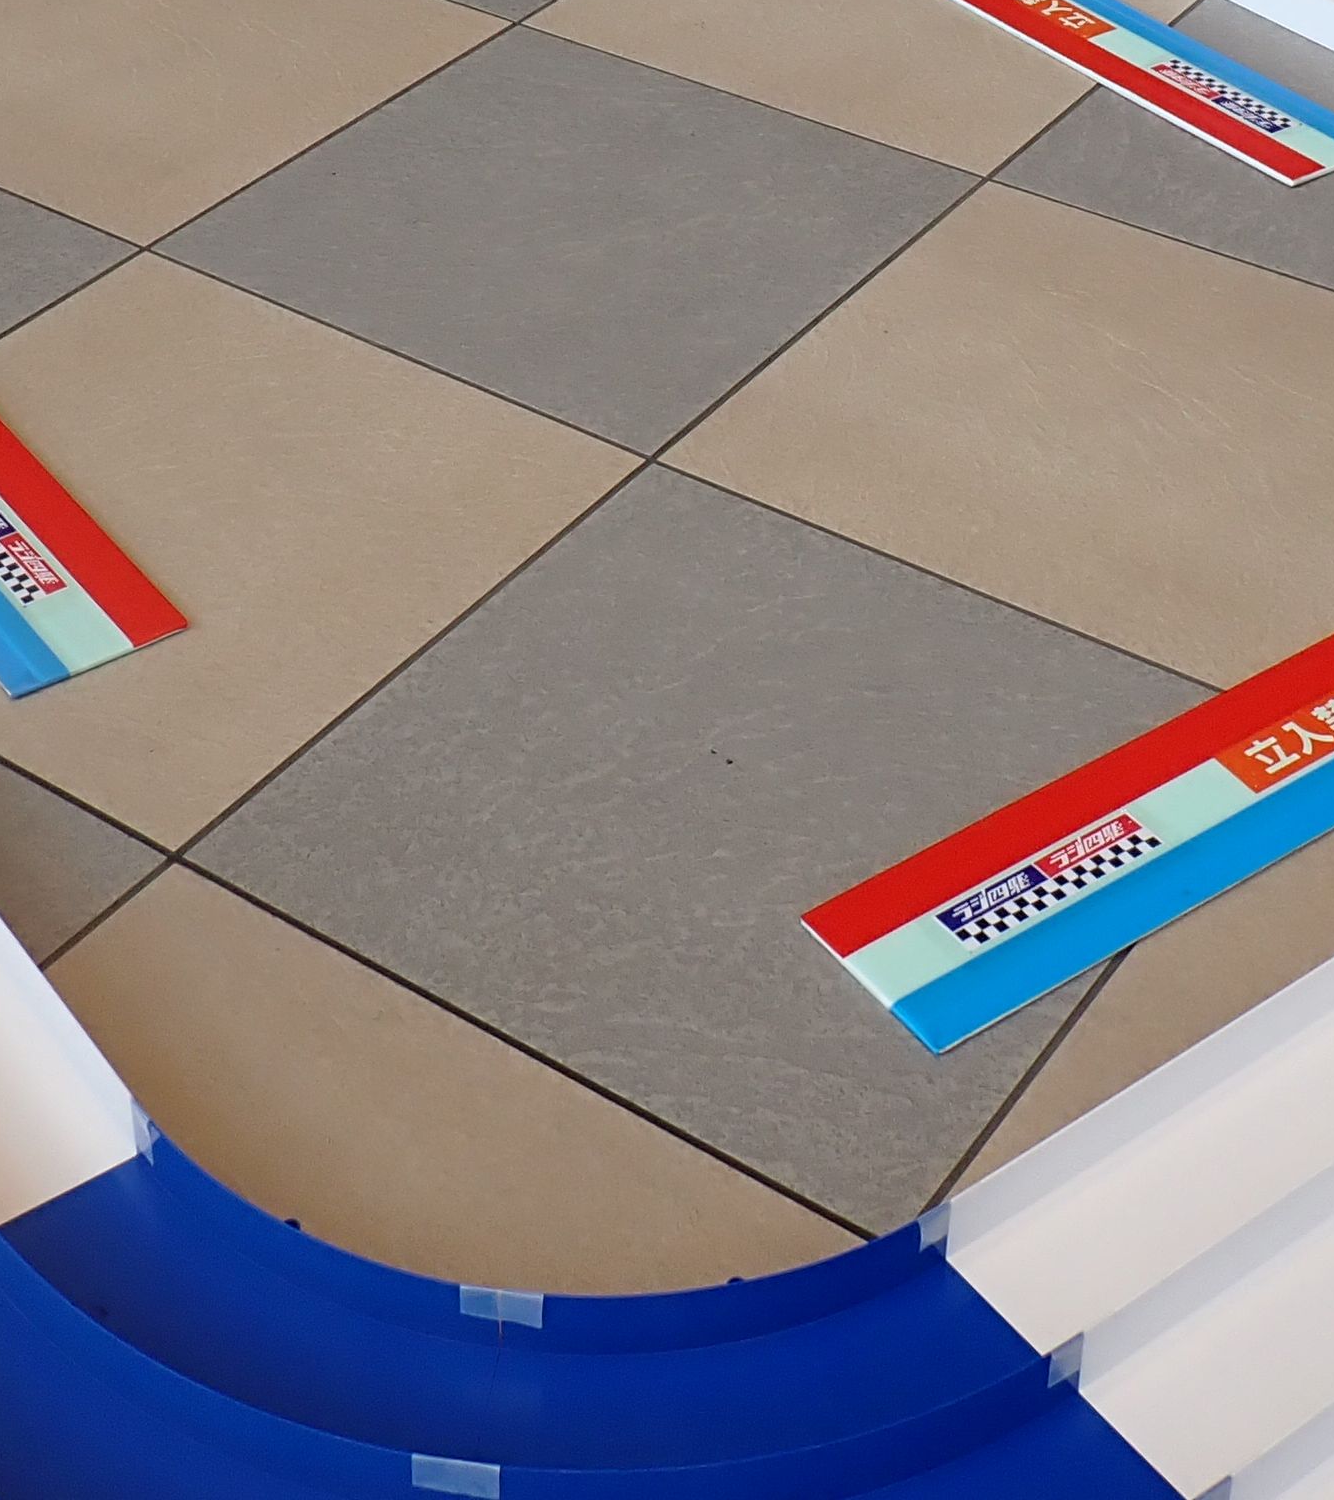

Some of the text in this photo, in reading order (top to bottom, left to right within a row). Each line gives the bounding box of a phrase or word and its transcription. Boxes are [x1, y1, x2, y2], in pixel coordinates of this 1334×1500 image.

[950, 822, 1123, 923] ラジ四駆 ラジ四駆
